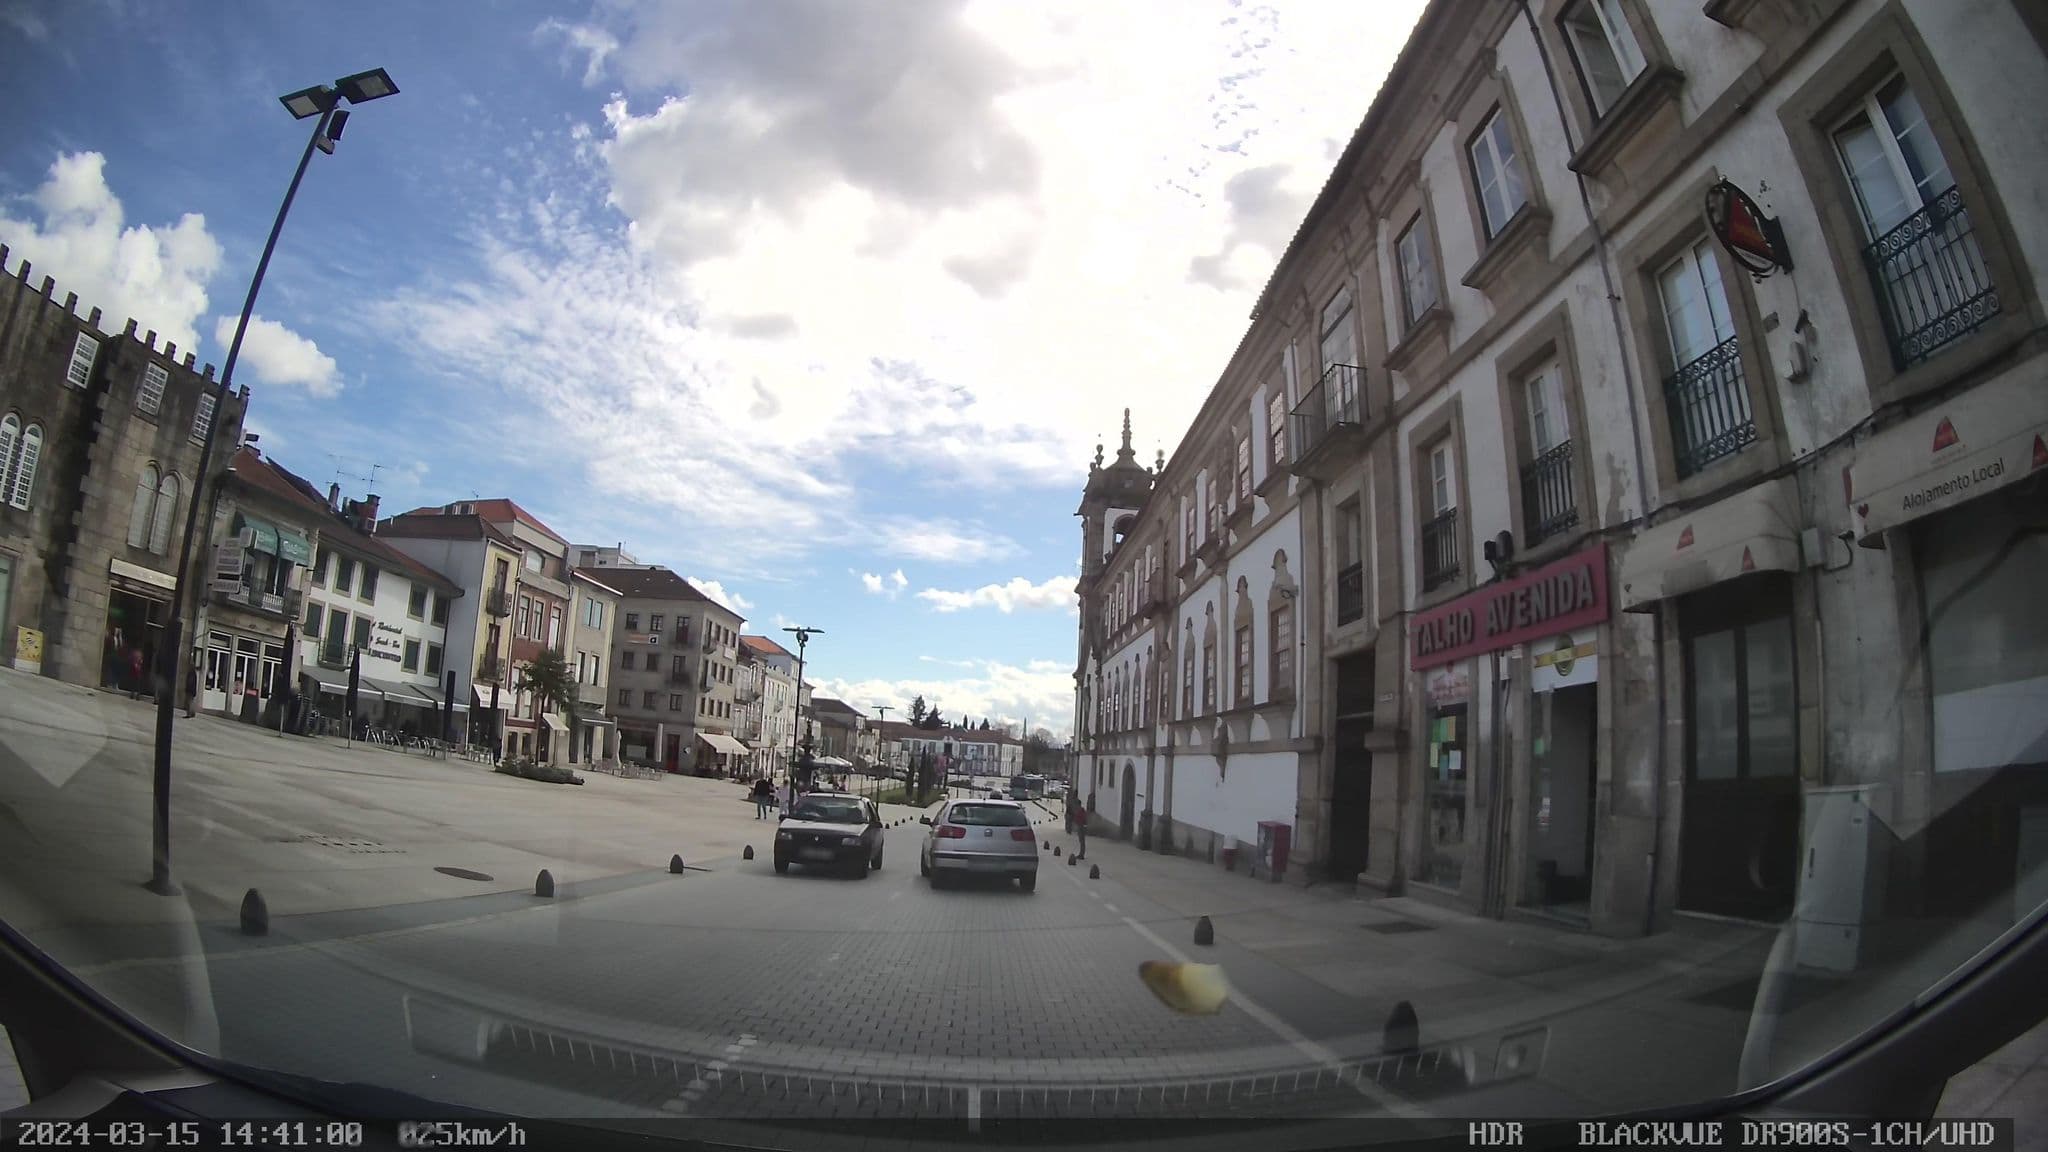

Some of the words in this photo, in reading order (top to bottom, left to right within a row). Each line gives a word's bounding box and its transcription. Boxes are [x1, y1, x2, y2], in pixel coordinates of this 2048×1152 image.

[1902, 474, 1971, 511] Alojamento
[1972, 457, 2006, 484] Local
[1411, 608, 1474, 657] TALHO
[1486, 563, 1595, 636] AVENIDA
